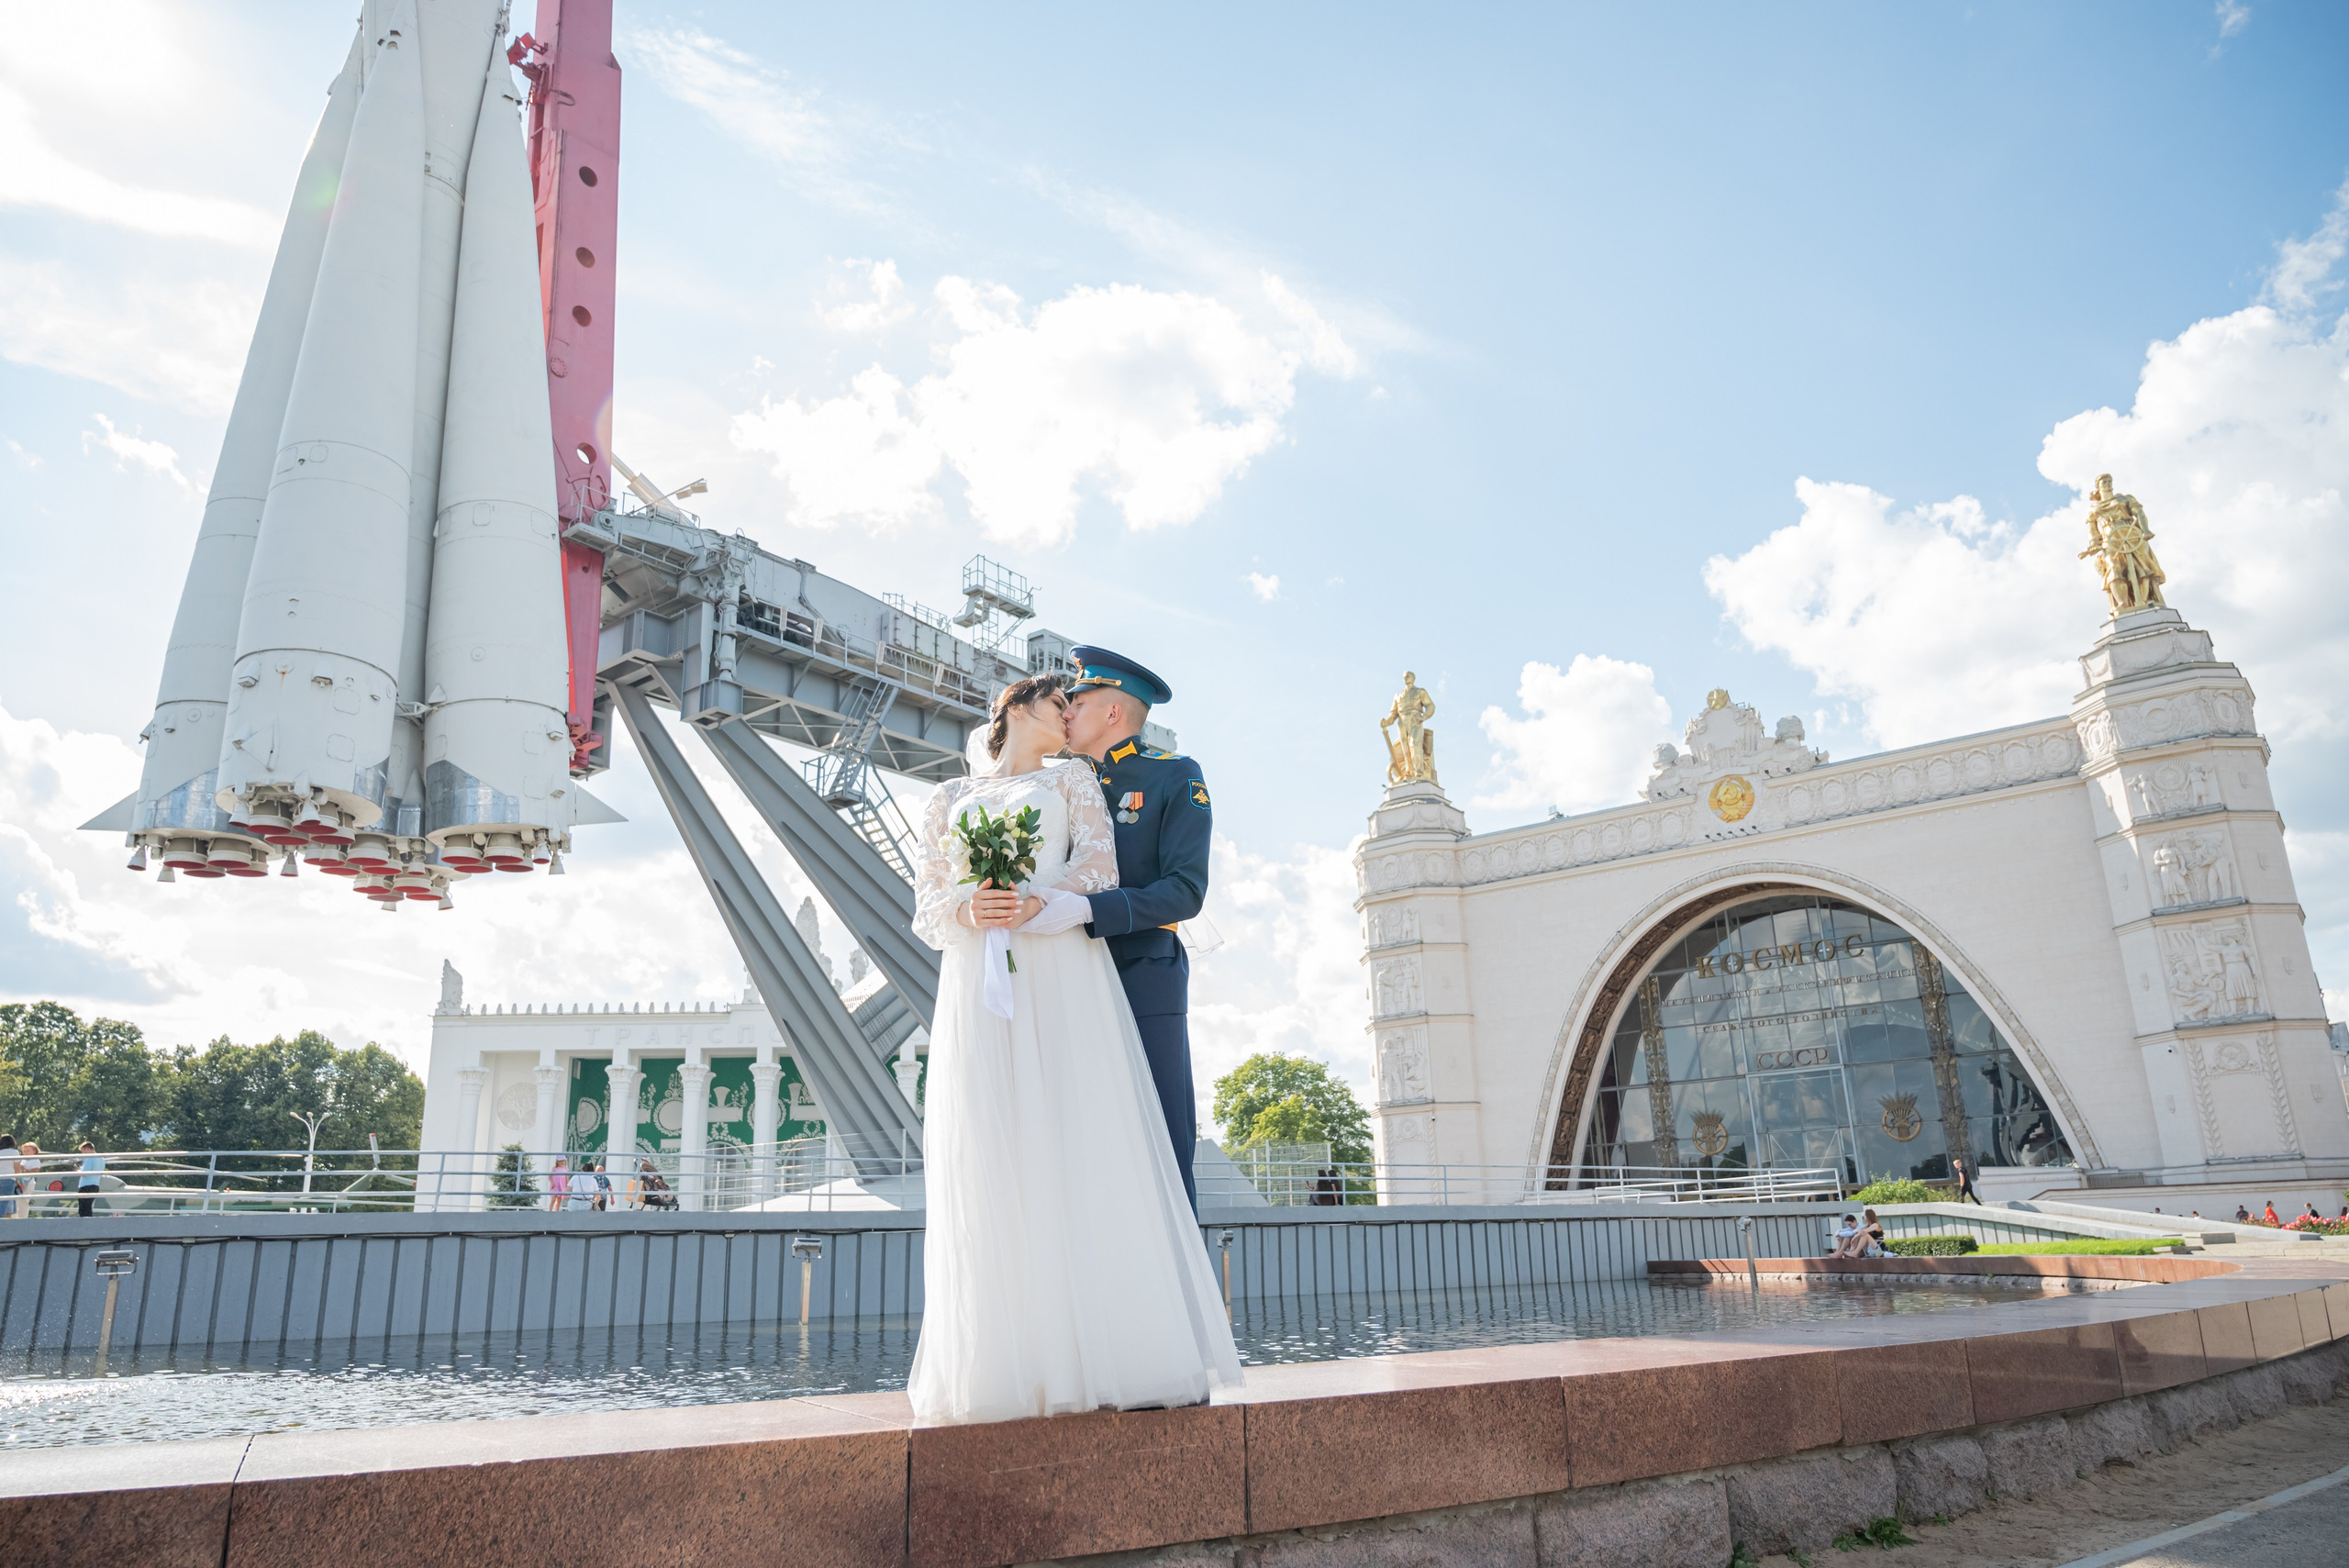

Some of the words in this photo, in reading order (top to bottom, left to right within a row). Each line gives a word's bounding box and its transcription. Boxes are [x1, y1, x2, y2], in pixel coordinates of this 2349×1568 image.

[1696, 934, 1865, 979] КОСМОС
[1702, 1018, 1785, 1034] СЕЛЬСКОГО
[1757, 1048, 1828, 1071] СССР
